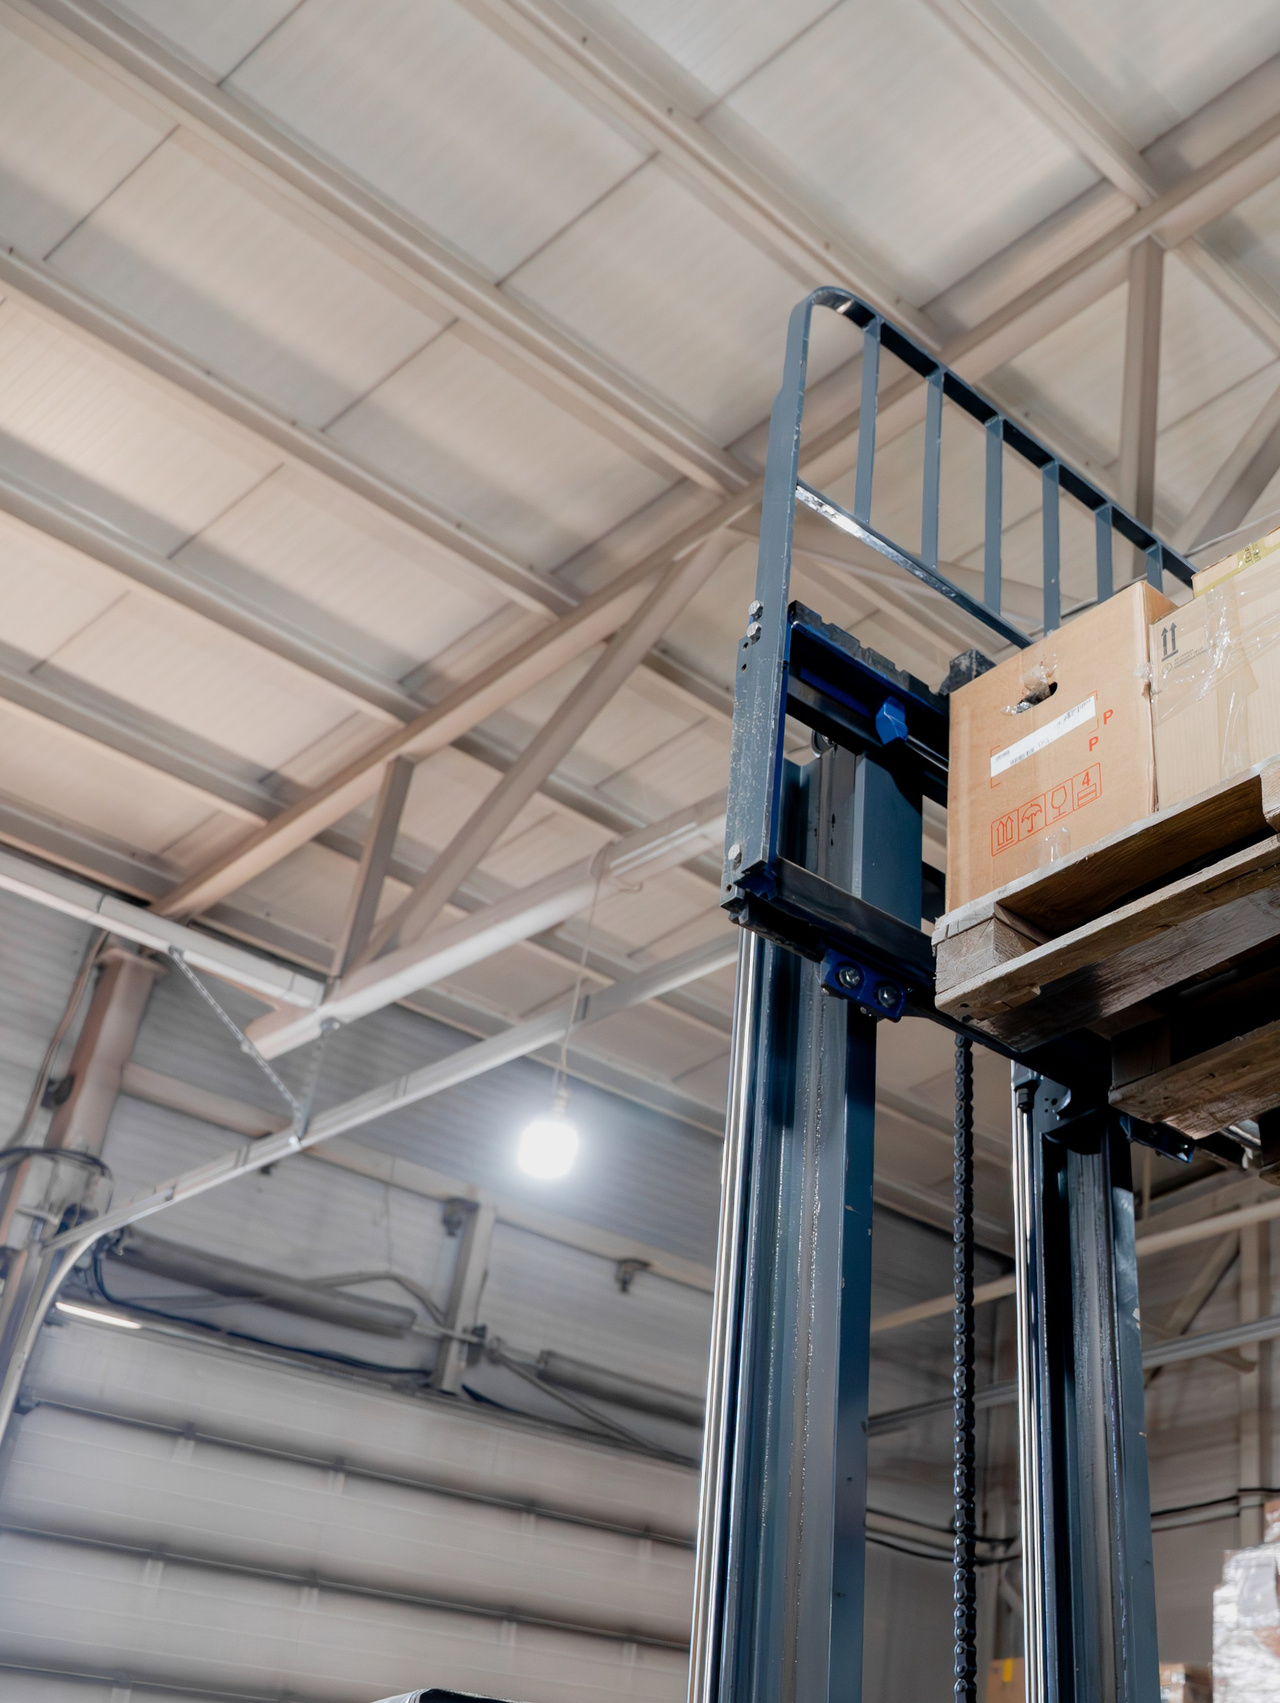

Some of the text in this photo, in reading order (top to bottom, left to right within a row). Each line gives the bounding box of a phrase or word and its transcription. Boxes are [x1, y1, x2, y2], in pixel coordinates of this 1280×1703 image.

[1103, 709, 1114, 725] P
[1088, 736, 1099, 752] P
[1081, 771, 1091, 787] 4
